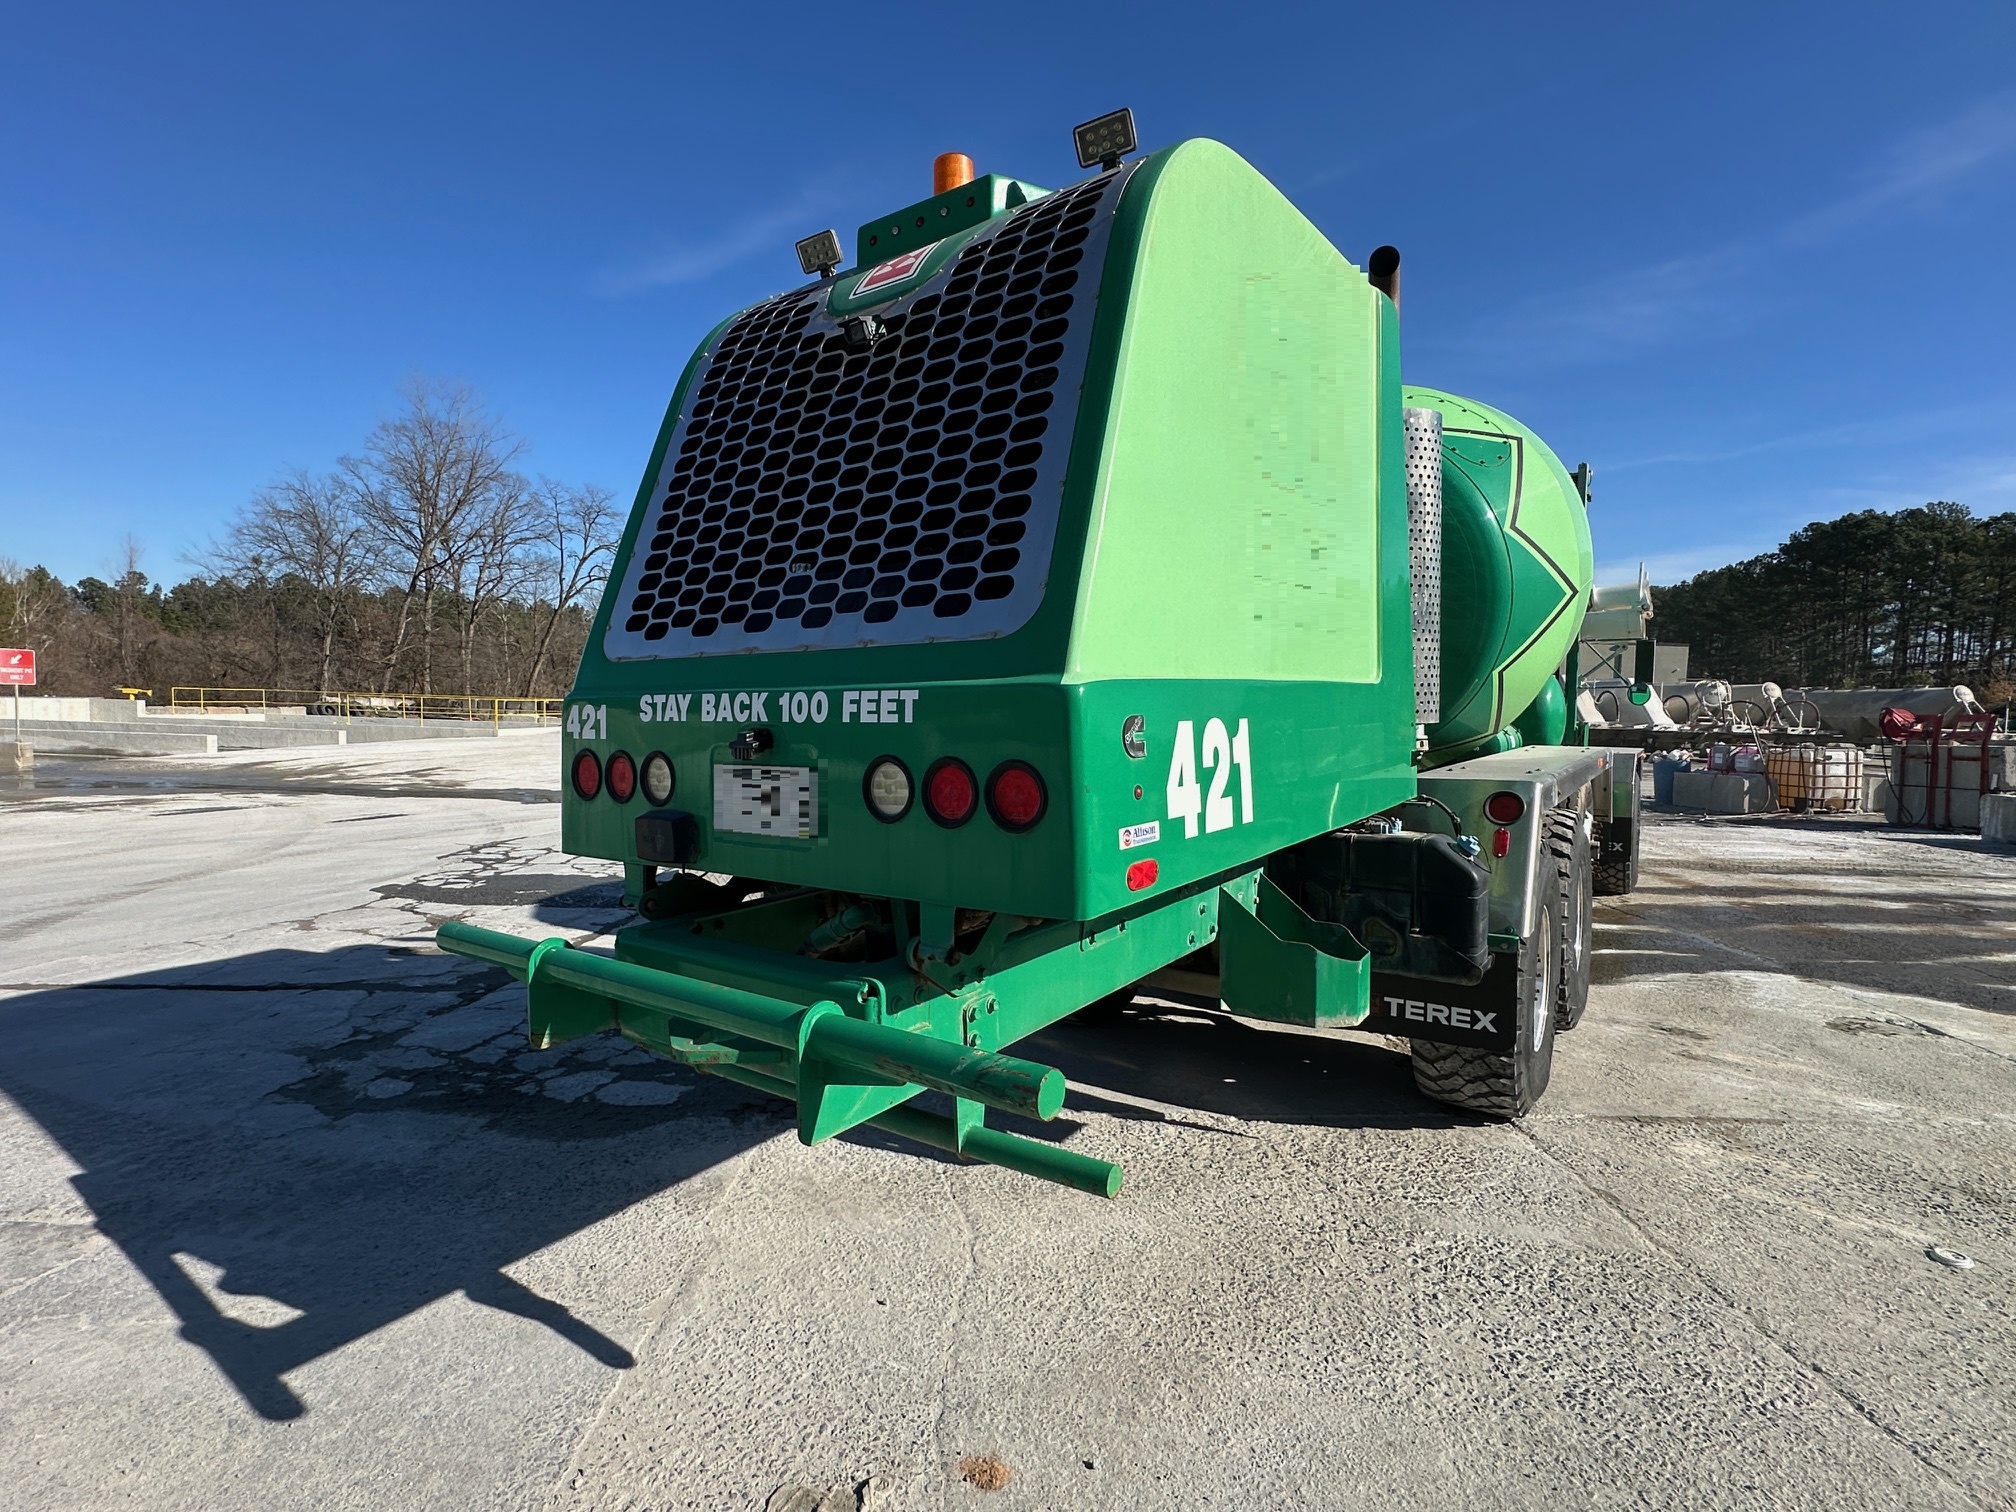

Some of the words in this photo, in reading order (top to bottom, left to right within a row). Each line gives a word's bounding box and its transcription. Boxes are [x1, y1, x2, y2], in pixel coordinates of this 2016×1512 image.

[566, 704, 607, 740] 421
[639, 694, 692, 722] STAY
[701, 692, 769, 722] BACK
[779, 691, 829, 723] 100
[842, 690, 919, 723] FEET
[1166, 717, 1254, 839] 421
[1383, 996, 1498, 1033] TEREX
